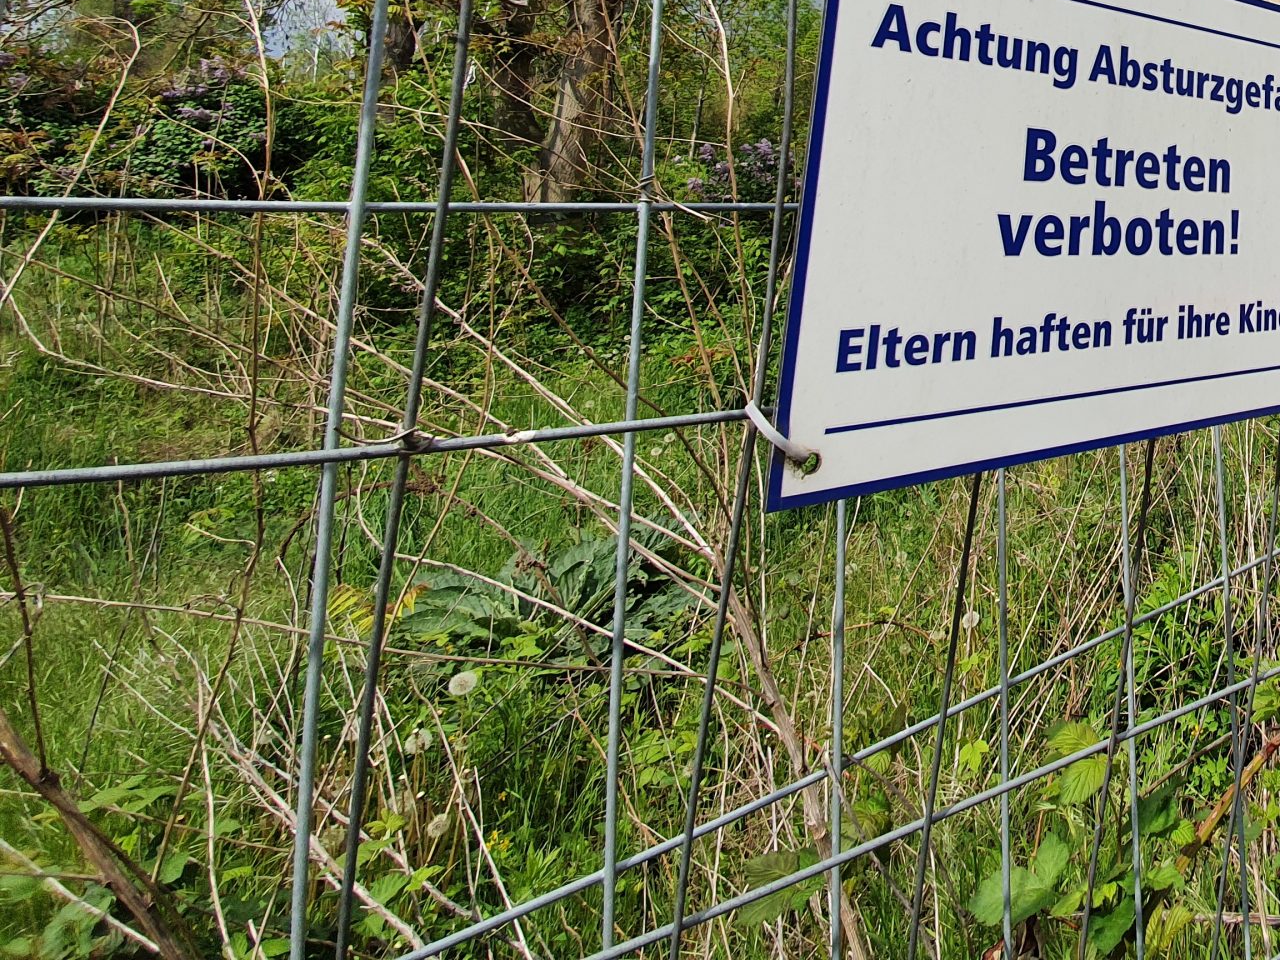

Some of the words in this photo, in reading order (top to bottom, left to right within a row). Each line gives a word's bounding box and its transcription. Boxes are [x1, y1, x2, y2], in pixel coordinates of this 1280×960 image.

[871, 3, 1079, 90] Achtung
[1023, 127, 1231, 194] Betreten
[997, 199, 1240, 257] verboten!
[835, 325, 977, 374] Eltern
[991, 308, 1112, 359] haften
[1122, 307, 1169, 346] für
[1178, 304, 1231, 340] ihre
